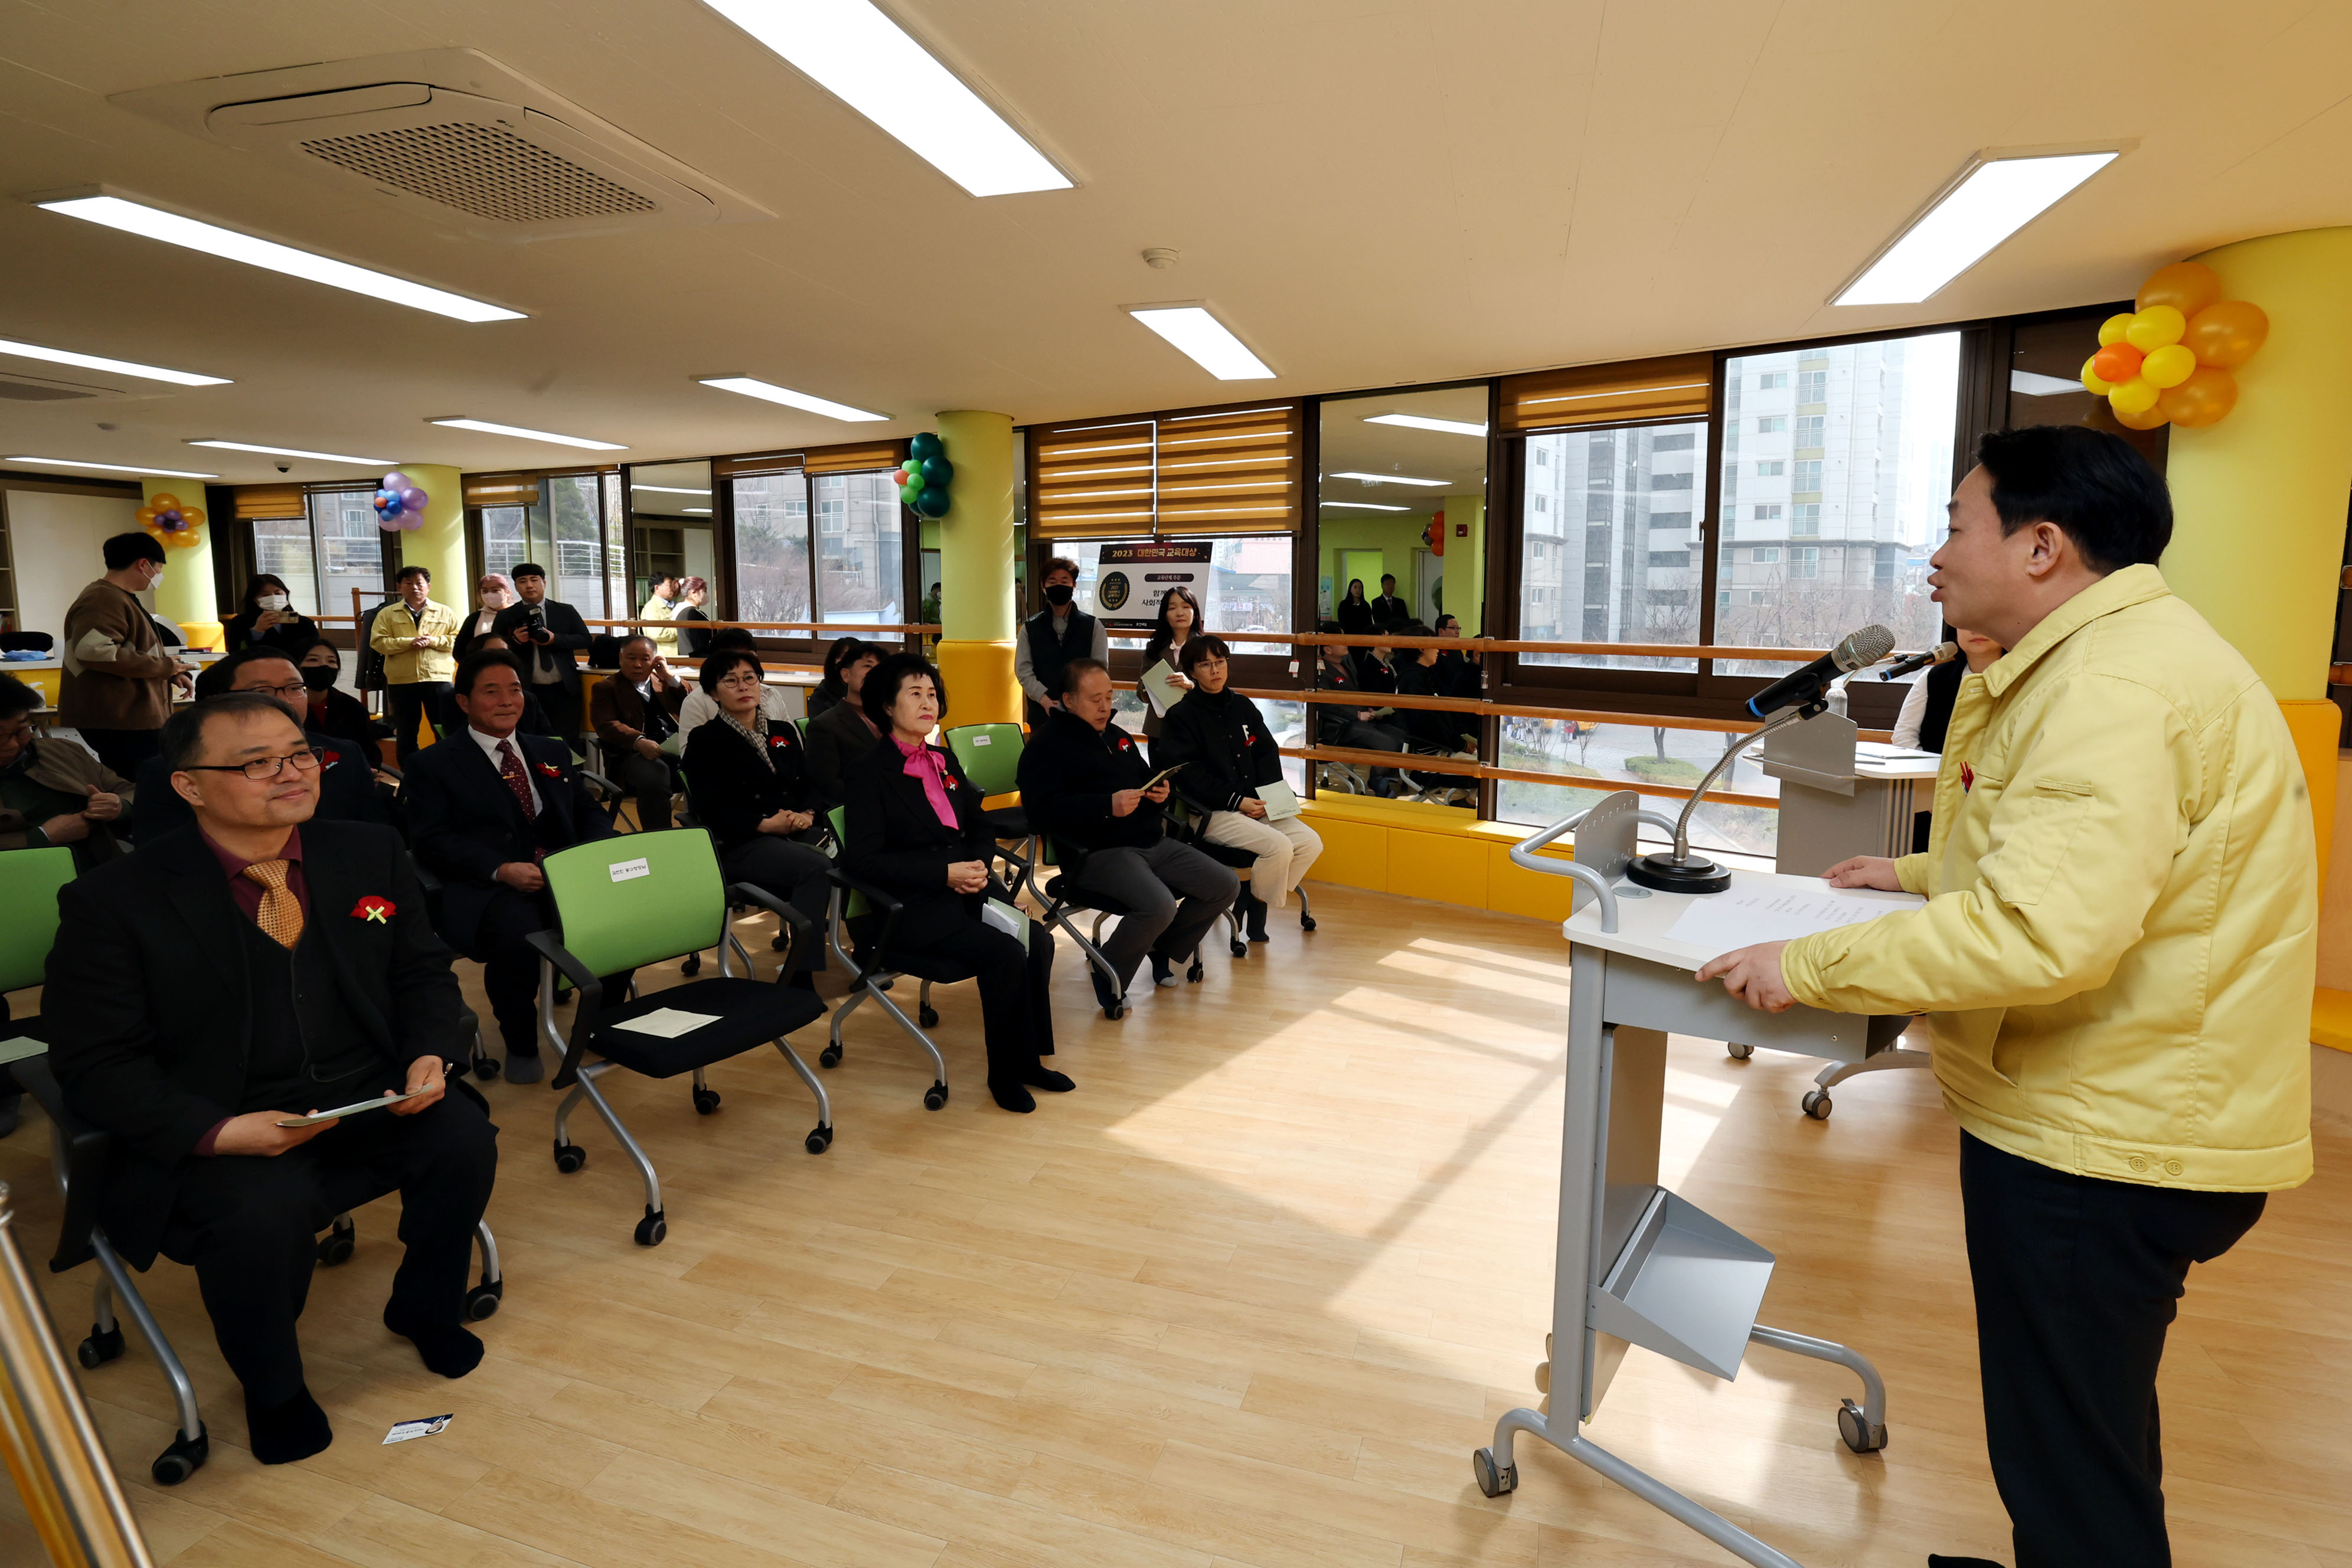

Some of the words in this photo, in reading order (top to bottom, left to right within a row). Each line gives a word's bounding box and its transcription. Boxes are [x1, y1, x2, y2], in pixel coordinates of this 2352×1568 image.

[1137, 548, 1165, 557] 대한민국
[1167, 547, 1197, 557] 교육대상
[1242, 725, 1249, 741] F
